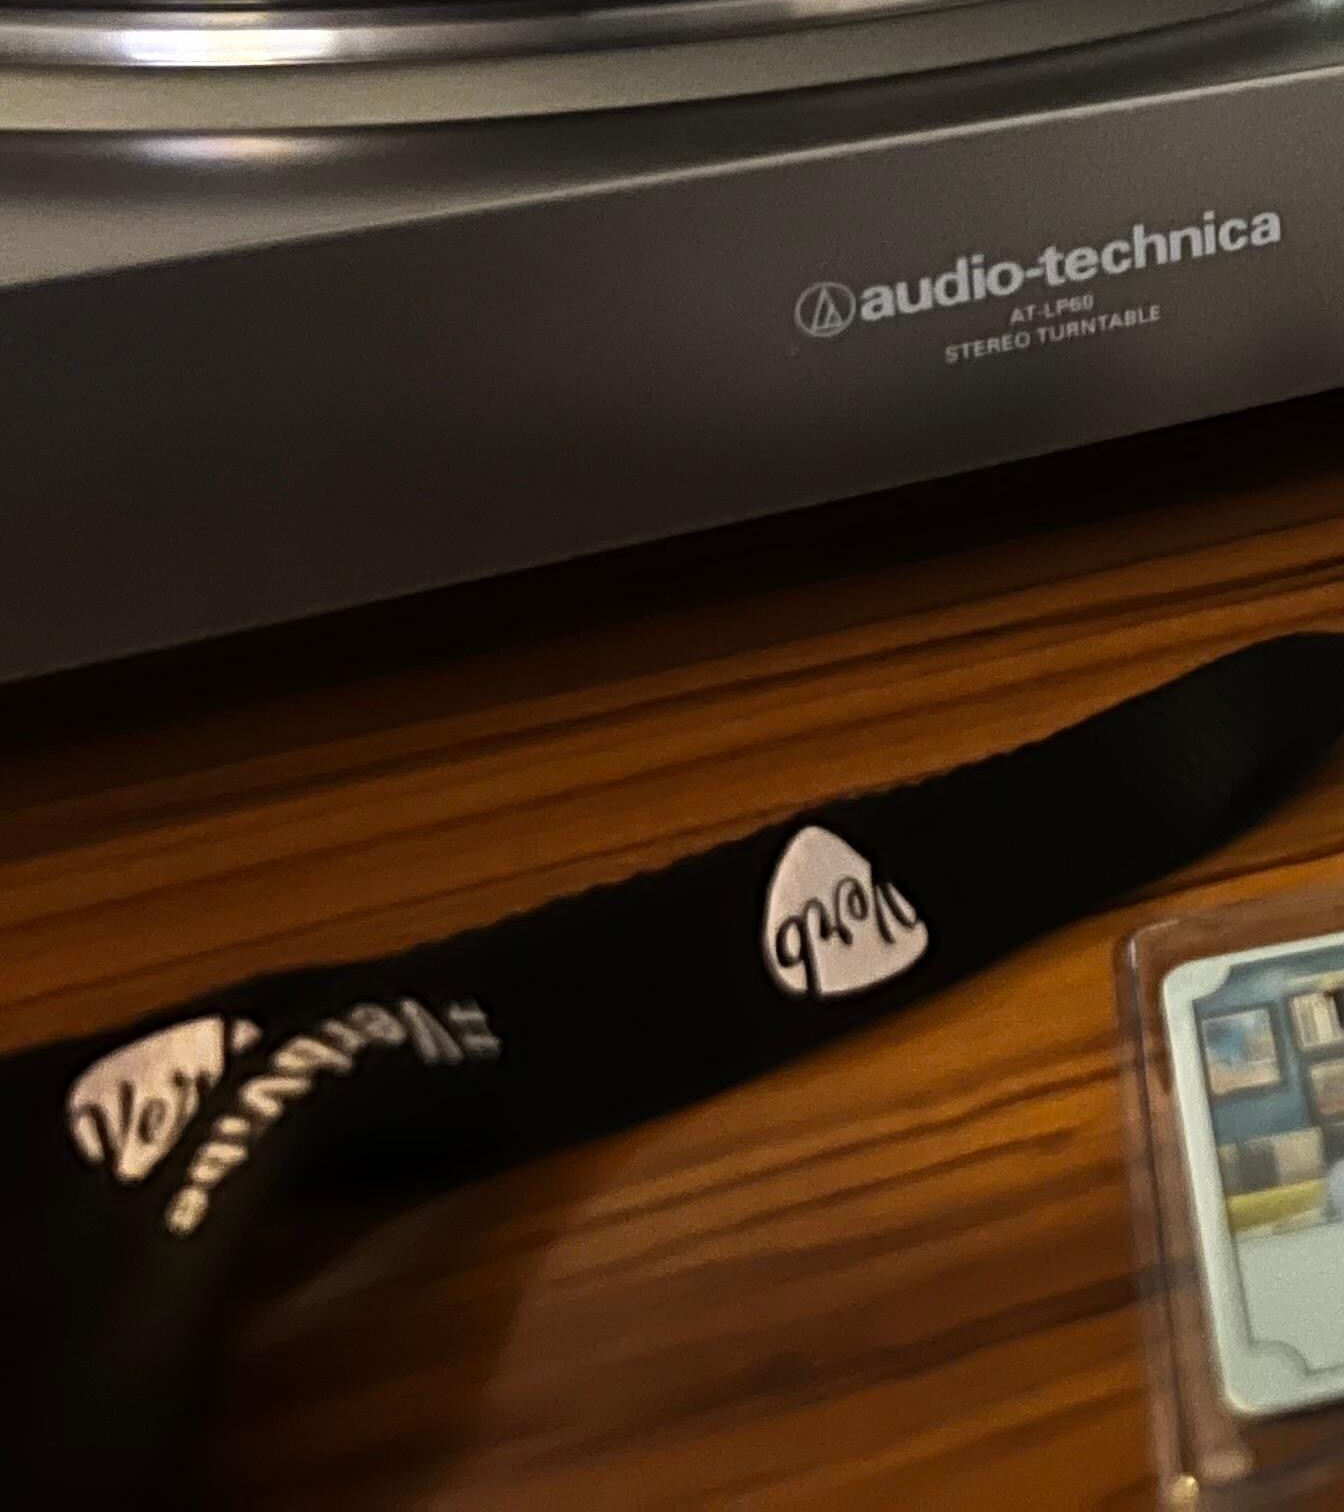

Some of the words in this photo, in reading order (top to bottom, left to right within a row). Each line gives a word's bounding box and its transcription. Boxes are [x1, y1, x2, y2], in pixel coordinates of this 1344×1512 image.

[860, 210, 1281, 322] audio-technica
[944, 330, 1031, 365] STEREO
[1037, 304, 1163, 346] TURNTABLE
[775, 876, 920, 994] Verb
